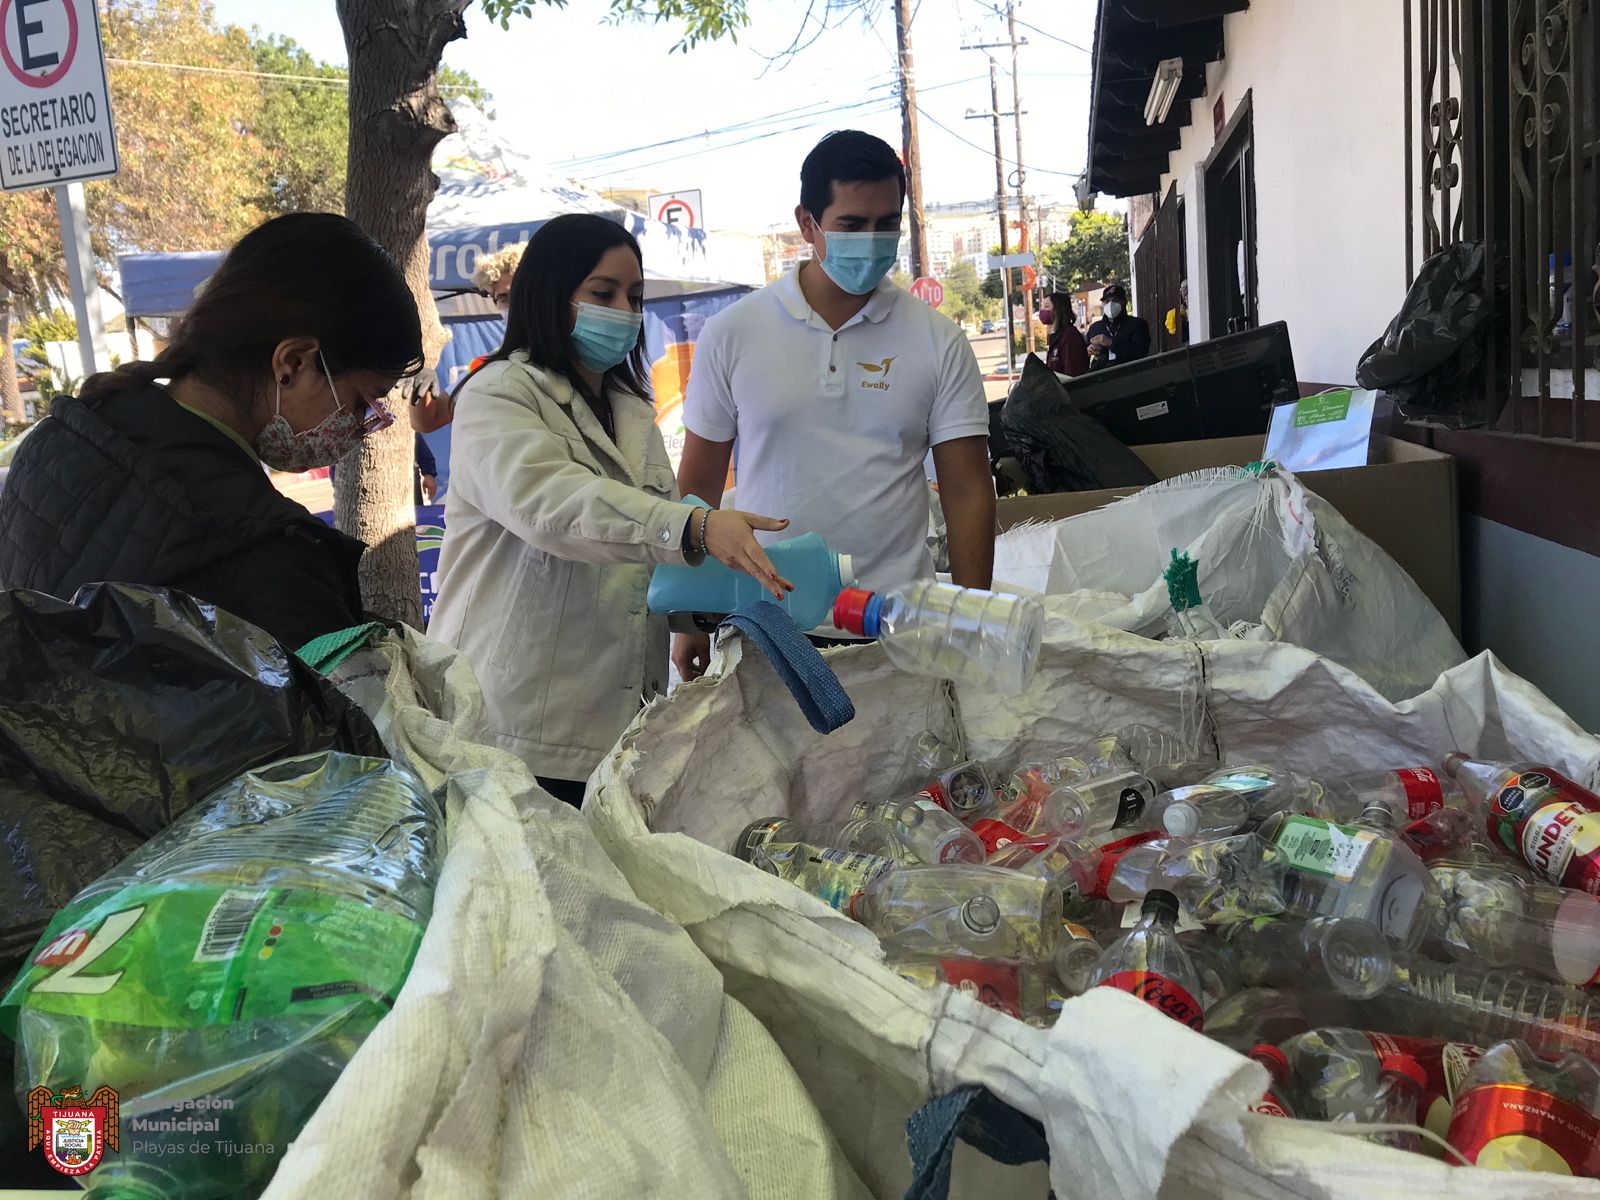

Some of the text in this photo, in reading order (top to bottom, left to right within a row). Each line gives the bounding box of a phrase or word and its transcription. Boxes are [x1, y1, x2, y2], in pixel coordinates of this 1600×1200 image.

[15, 0, 60, 71] E
[1, 91, 97, 138] SECRETARIO
[7, 130, 105, 176] DE LA DELEGACION
[1535, 803, 1585, 871] UNDET
[1502, 1101, 1556, 1121] MANZANA
